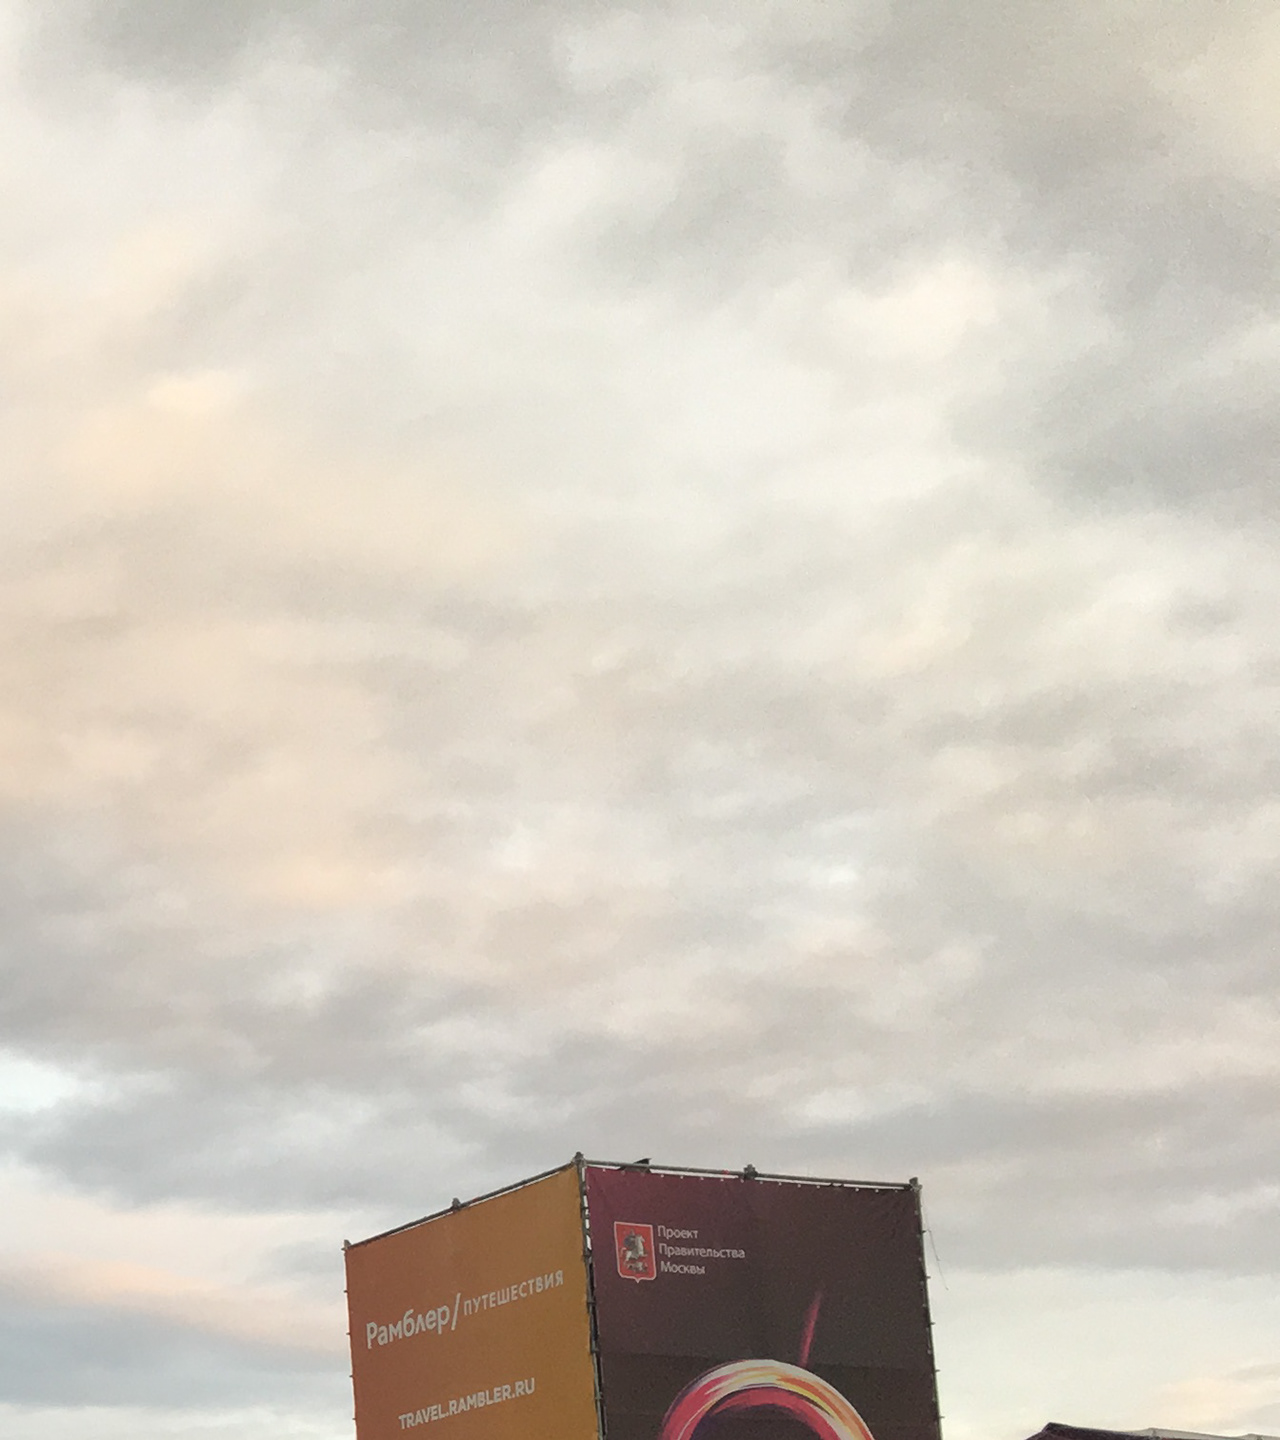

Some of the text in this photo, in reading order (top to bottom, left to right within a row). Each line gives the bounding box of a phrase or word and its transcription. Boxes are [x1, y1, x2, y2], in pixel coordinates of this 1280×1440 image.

[657, 1225, 698, 1240] Проект
[659, 1243, 745, 1258] Правительства
[660, 1260, 706, 1275] Москвы
[398, 1377, 536, 1430] TRAVEL.RAMBLER.RU
